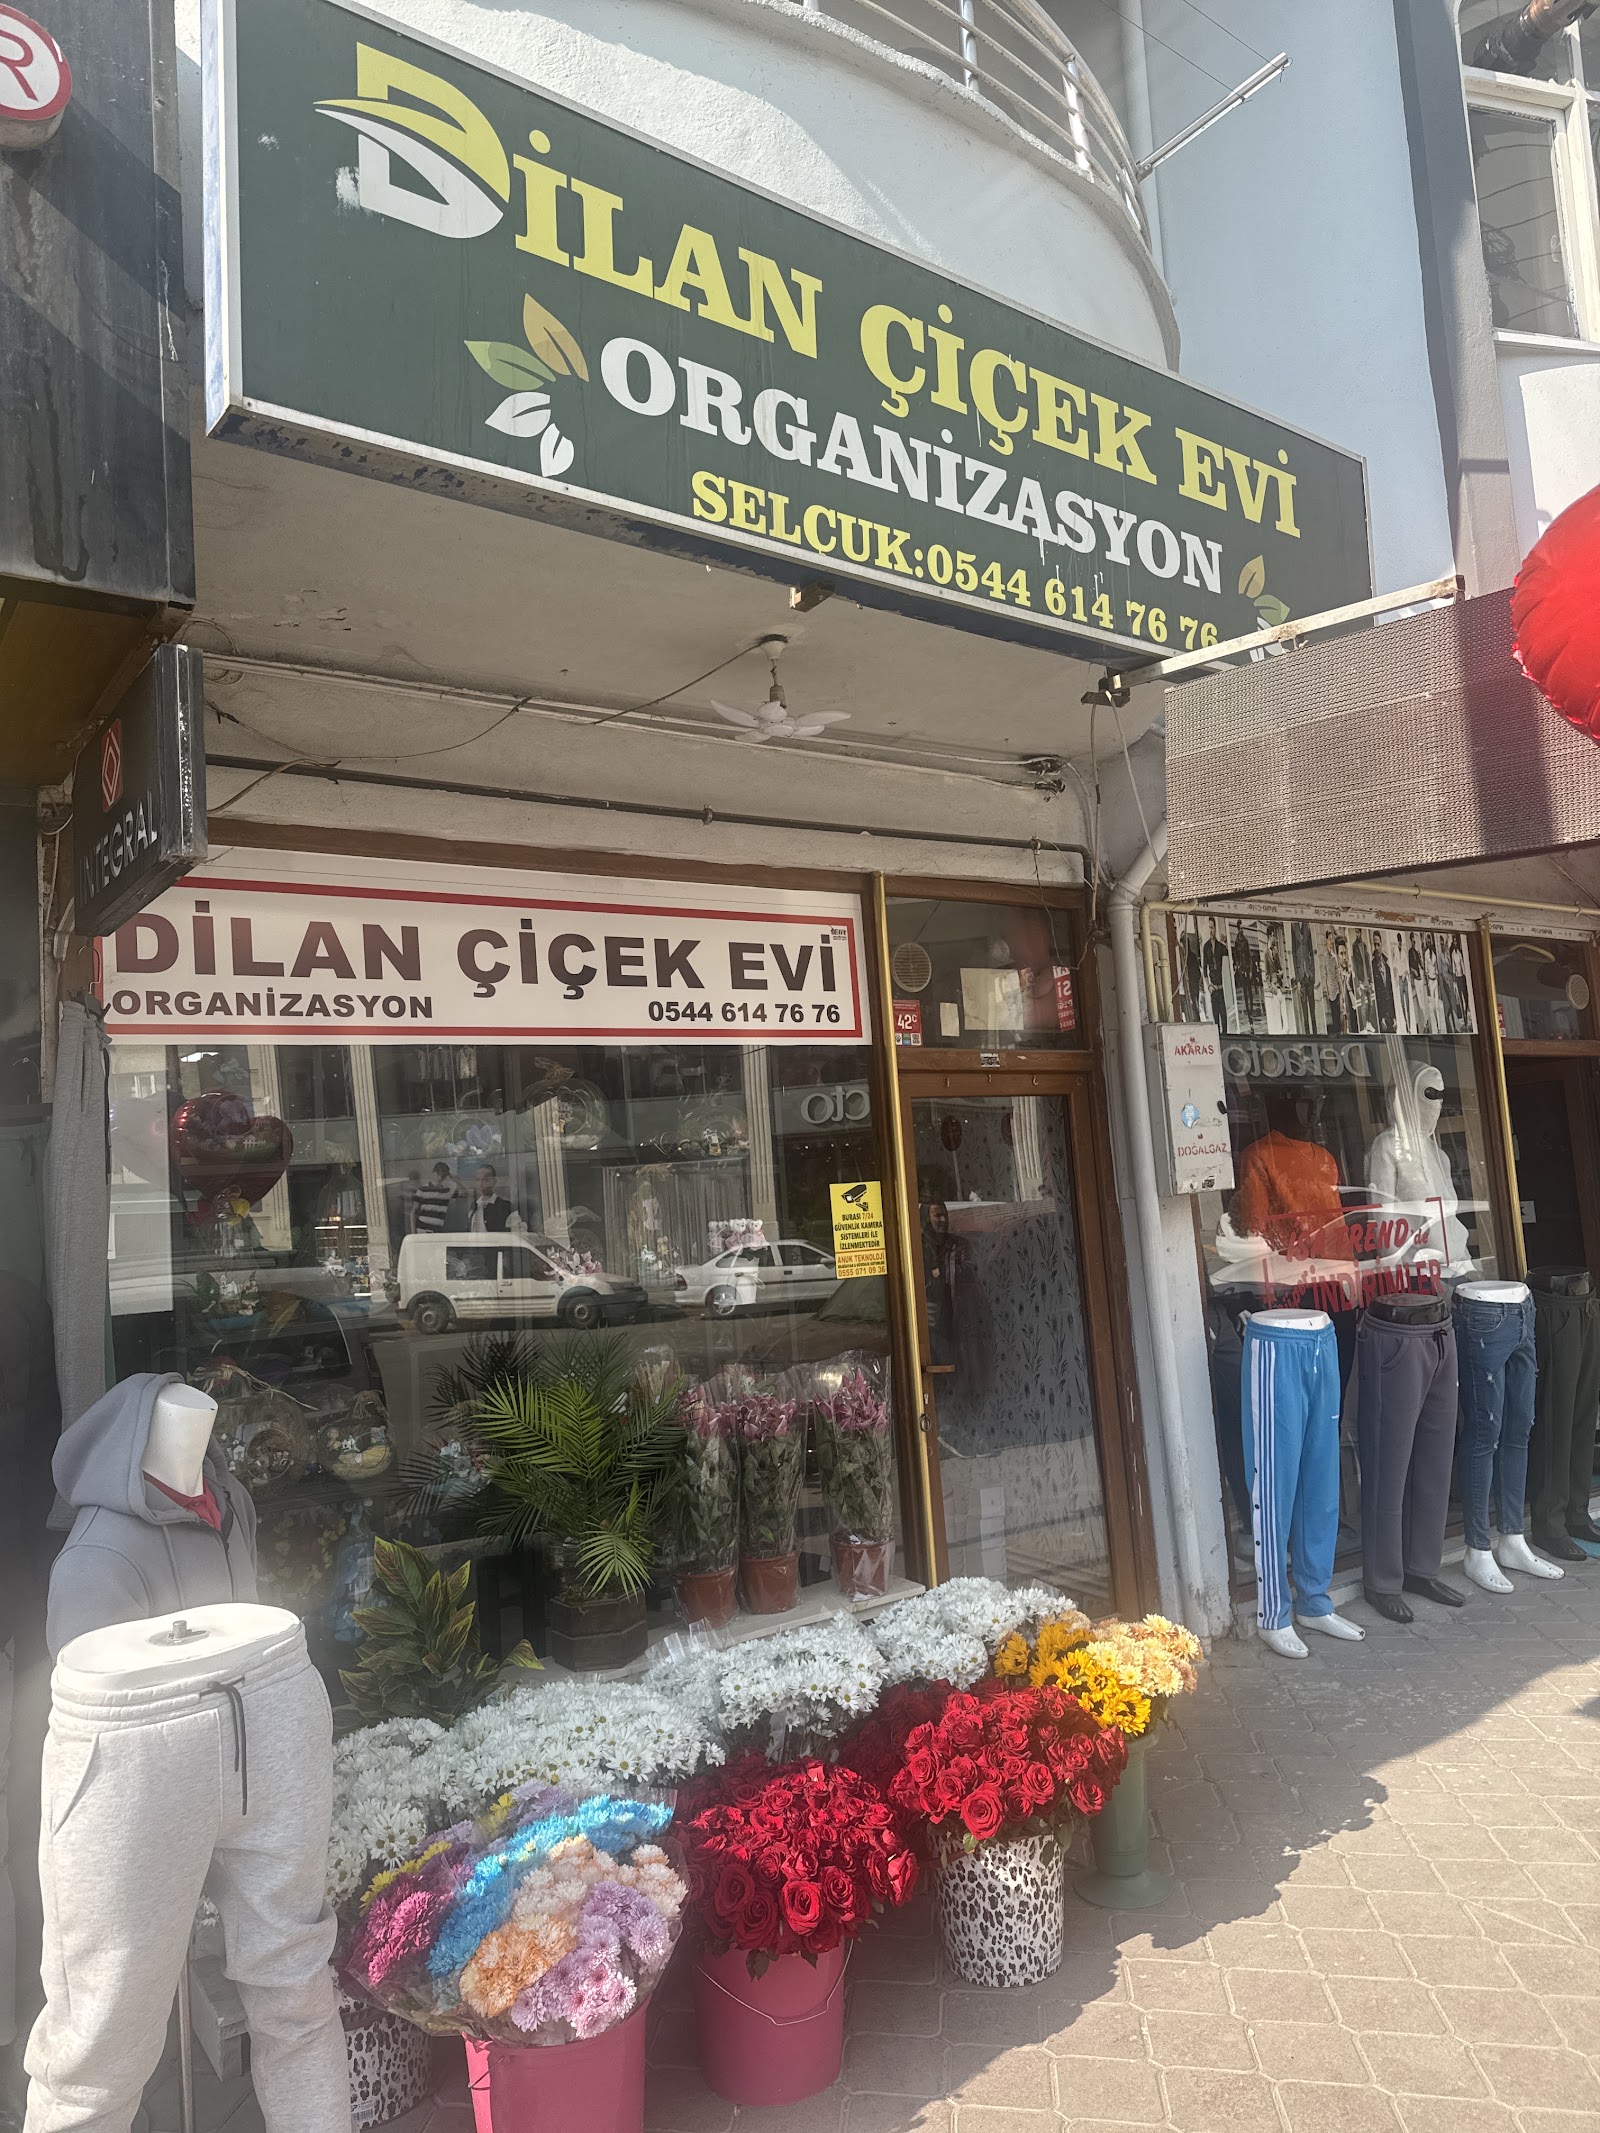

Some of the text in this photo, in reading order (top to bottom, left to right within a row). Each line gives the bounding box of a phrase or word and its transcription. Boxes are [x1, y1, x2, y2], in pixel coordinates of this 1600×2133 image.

[313, 42, 1301, 539] DİLAN ÇİÇEK EVİ
[600, 337, 1223, 594] ORGANİZASYON
[1045, 578, 1114, 629] 614
[1126, 600, 1168, 643] 76
[1180, 615, 1218, 650] 76
[115, 900, 836, 999] DİLAN ÇİÇEK EVİ
[112, 987, 433, 1018] ORGANİZASYON
[648, 1001, 841, 1024] 0544 614 76 76
[1174, 1044, 1214, 1056] AKARAS
[842, 1212, 874, 1221] BURASI 7/24
[834, 1221, 882, 1231] GÜVENLİK KAMERA
[840, 1231, 870, 1240] SİSTEMLERİ
[840, 1239, 880, 1250] İZLENMEKTEDİR
[854, 1251, 884, 1262] TEKNOLOJİ
[838, 1269, 854, 1277] 0555
